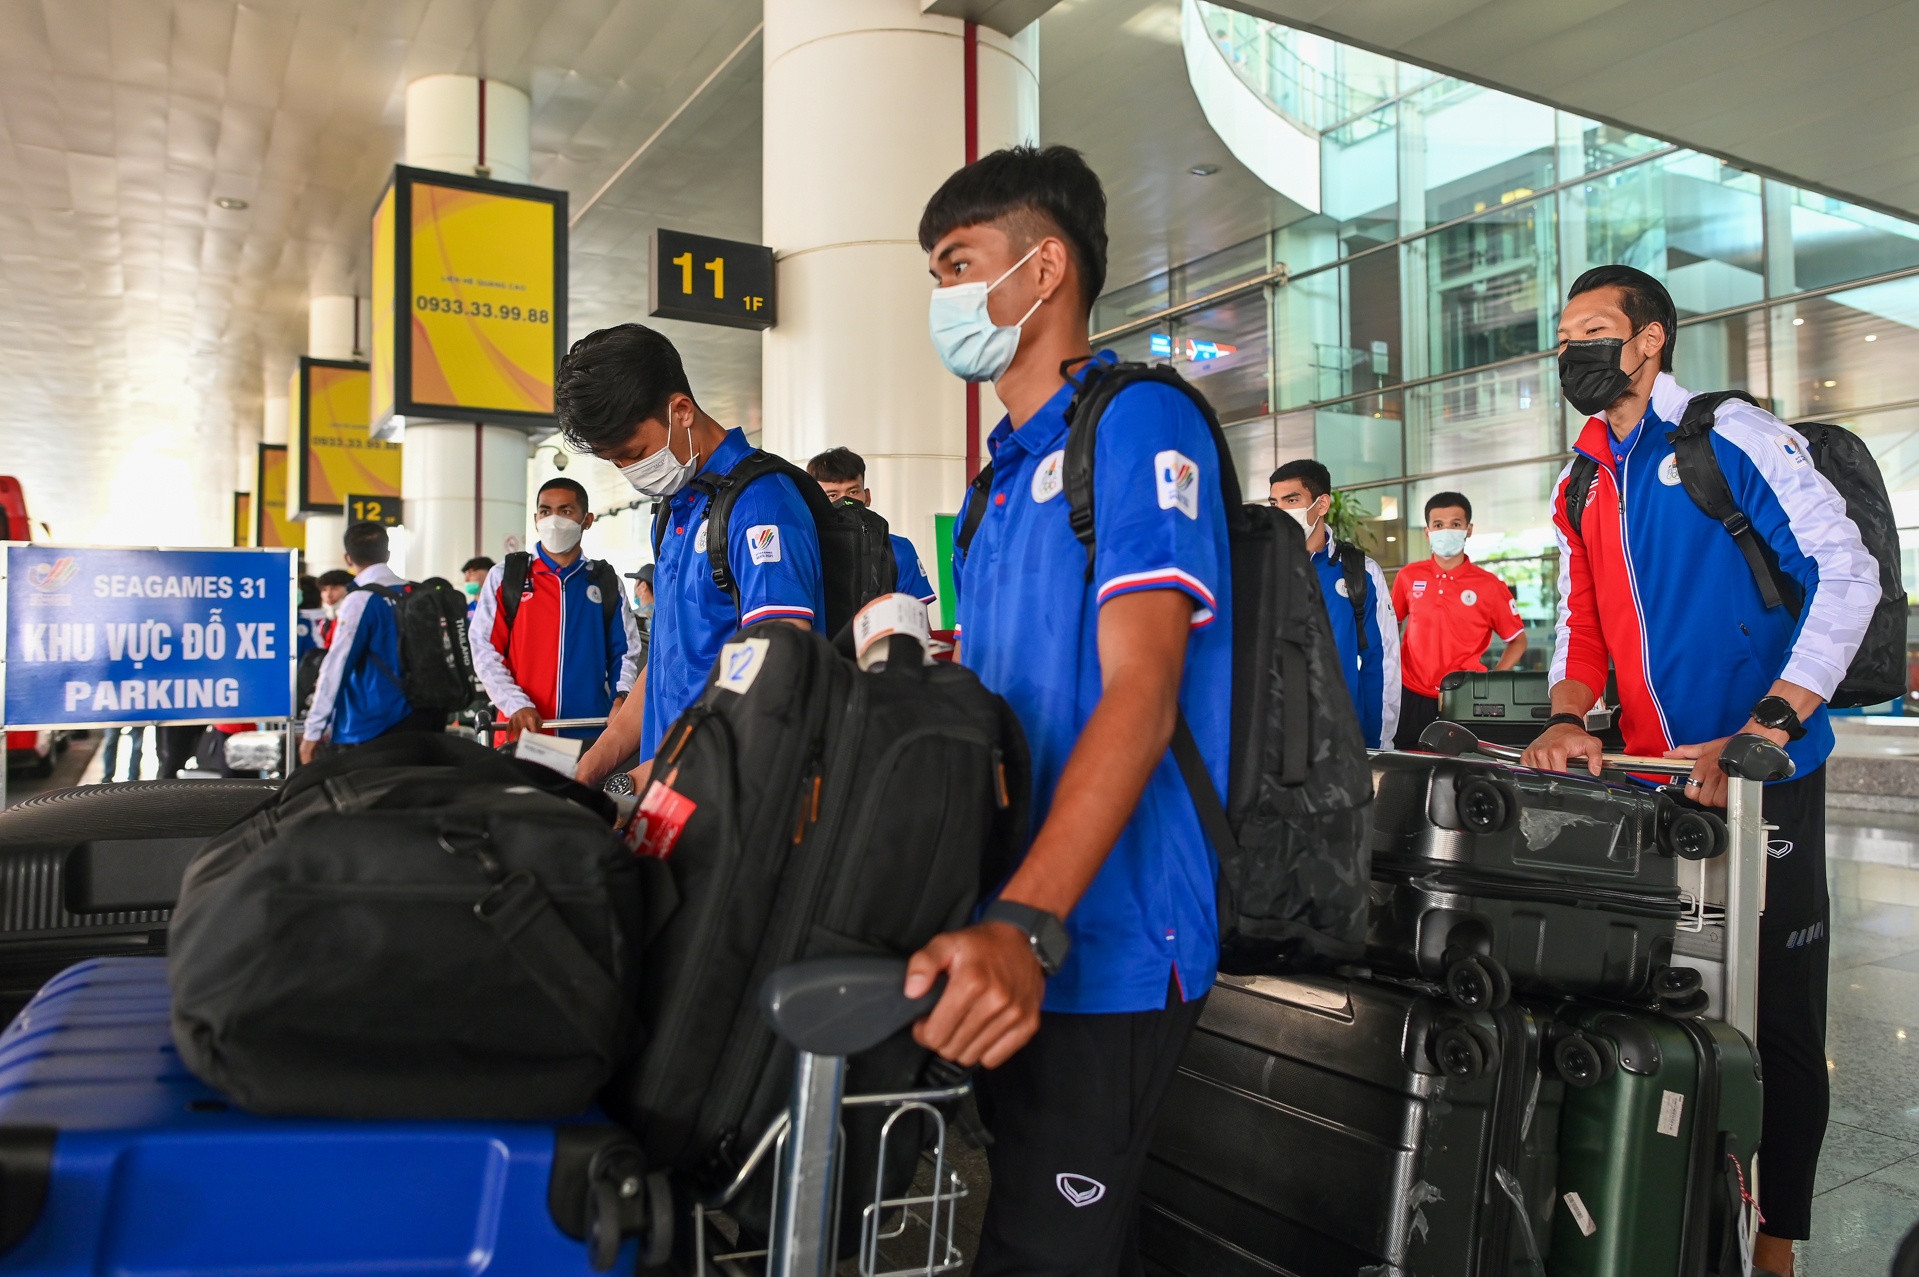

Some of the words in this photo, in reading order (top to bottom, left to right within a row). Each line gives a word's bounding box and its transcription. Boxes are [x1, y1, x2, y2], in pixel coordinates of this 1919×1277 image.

[673, 252, 724, 299] 11
[416, 295, 550, 324] 0933.33.99.88
[743, 296, 763, 311] 1F
[353, 501, 382, 521] 12
[93, 574, 234, 599] SEAGAMES
[239, 577, 266, 599] 31
[23, 622, 95, 662] KHU
[106, 619, 173, 669] VỰC
[181, 607, 227, 661] ĐỖ
[235, 622, 276, 660] XE
[65, 677, 240, 712] PARKING
